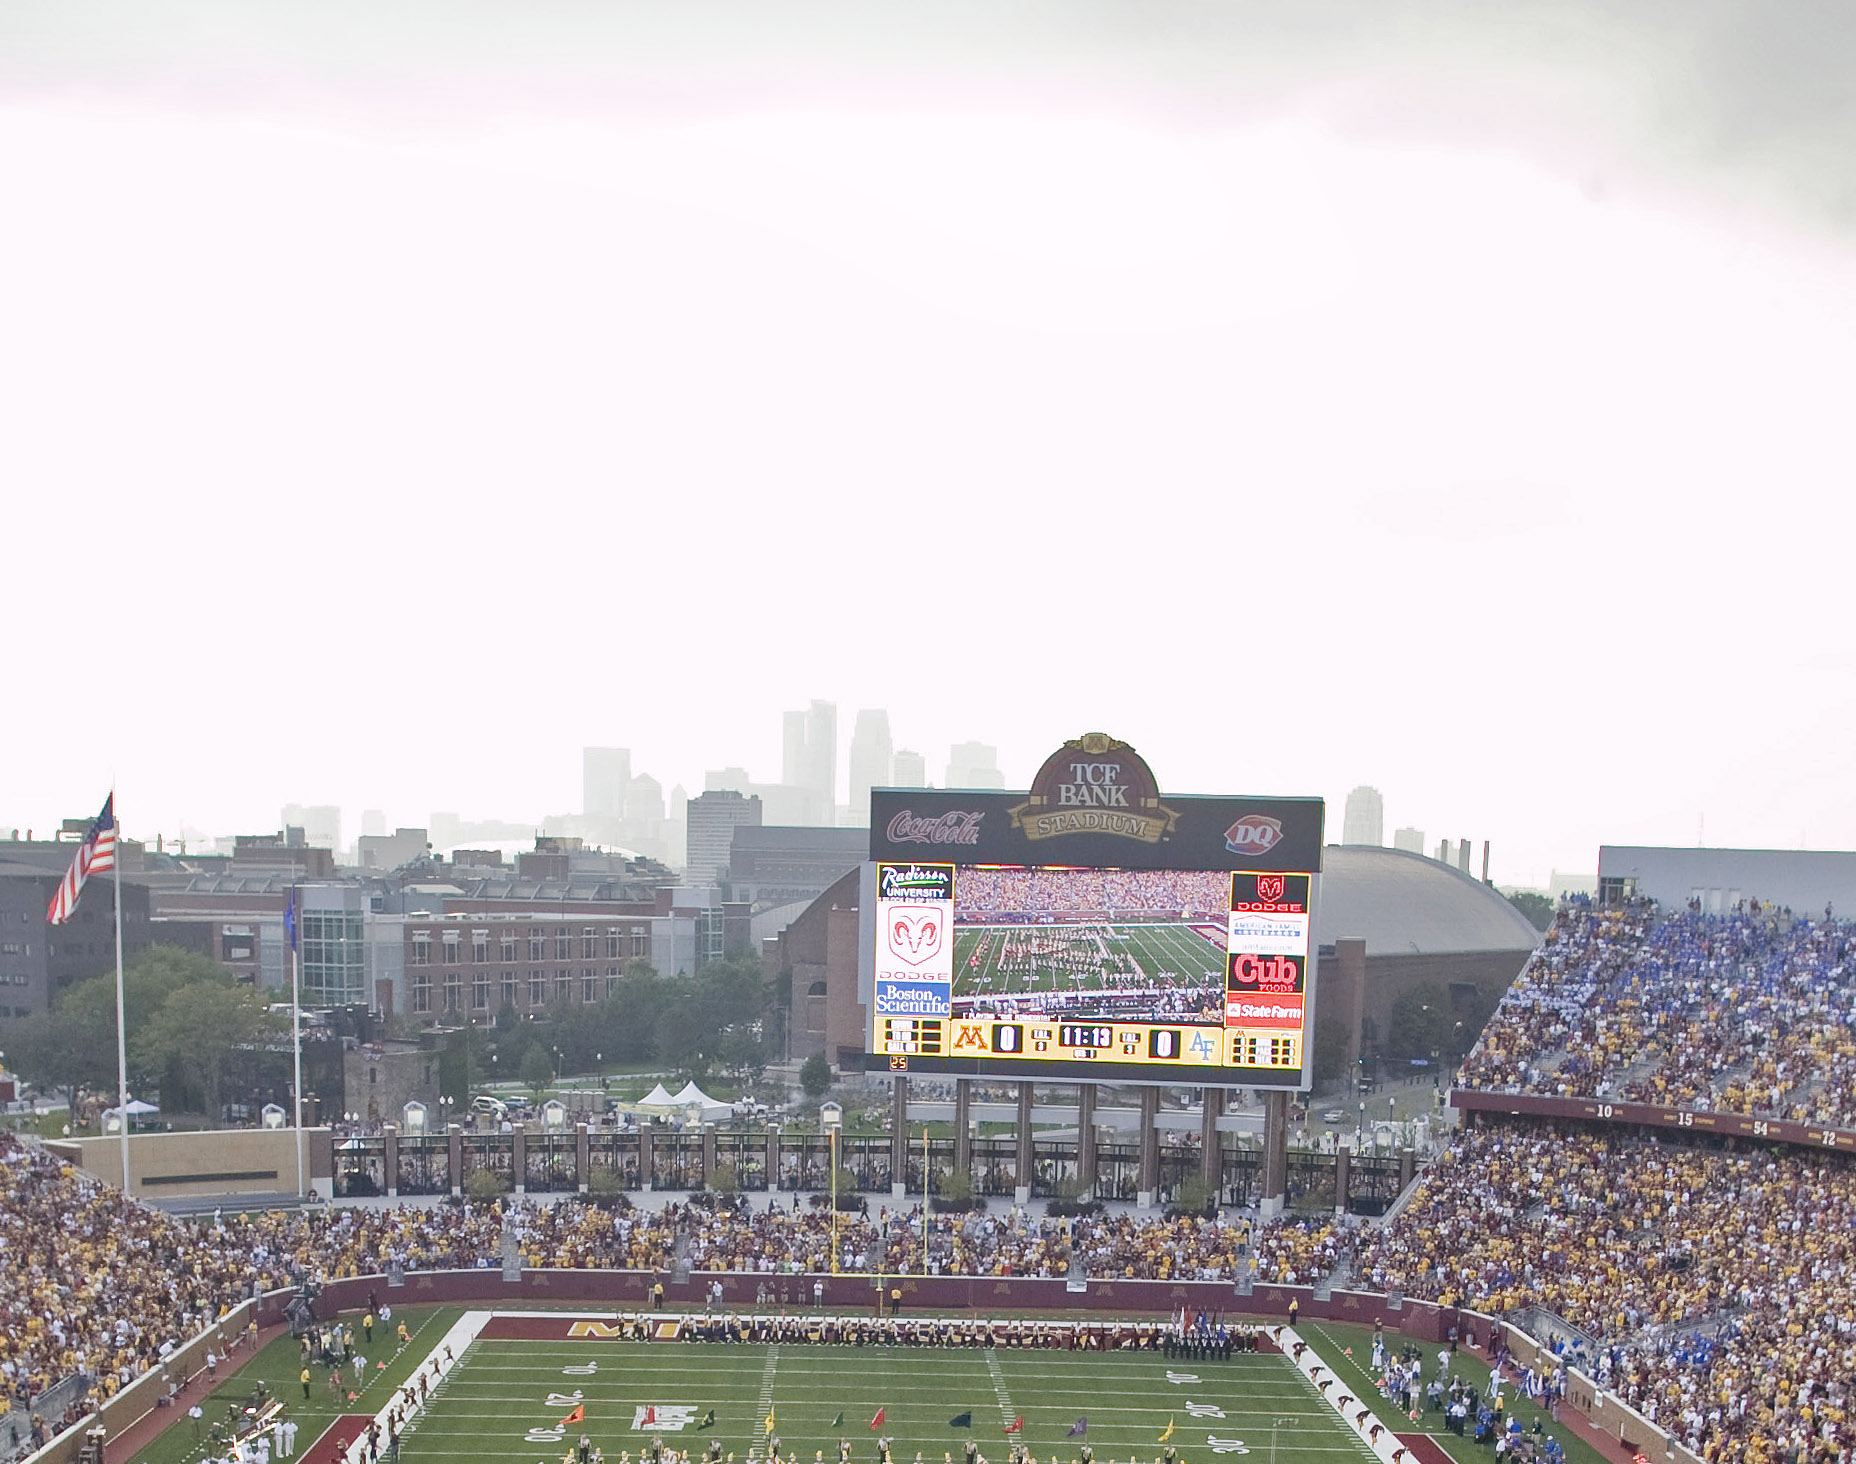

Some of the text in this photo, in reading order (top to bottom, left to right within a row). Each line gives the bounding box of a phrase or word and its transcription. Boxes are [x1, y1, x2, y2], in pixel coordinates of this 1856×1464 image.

[1070, 763, 1120, 785] TCF
[1058, 784, 1129, 807] BANK
[886, 810, 985, 845] Coca-Cola
[1038, 809, 1147, 840] STADIUM
[1235, 825, 1276, 849] DQ
[882, 866, 948, 889] Radisson
[886, 888, 945, 898] UNIVERSITY
[1237, 902, 1302, 912] DODGE
[879, 972, 949, 981] DODGE
[1234, 954, 1297, 984] Cub
[887, 985, 933, 1000] Boston
[1258, 984, 1294, 992] FOODS
[876, 994, 950, 1014] Scientific
[953, 1024, 989, 1050] M
[1000, 1025, 1016, 1052] 0
[1063, 1027, 1112, 1048] 11:13
[1156, 1030, 1172, 1057] 0
[890, 1057, 907, 1069] 25
[1596, 1104, 1613, 1118] 10
[1677, 1112, 1693, 1126] 15
[1753, 1121, 1768, 1136] 54
[1823, 1130, 1836, 1146] 72
[524, 1427, 566, 1443] 30
[1207, 1439, 1251, 1455] 30
